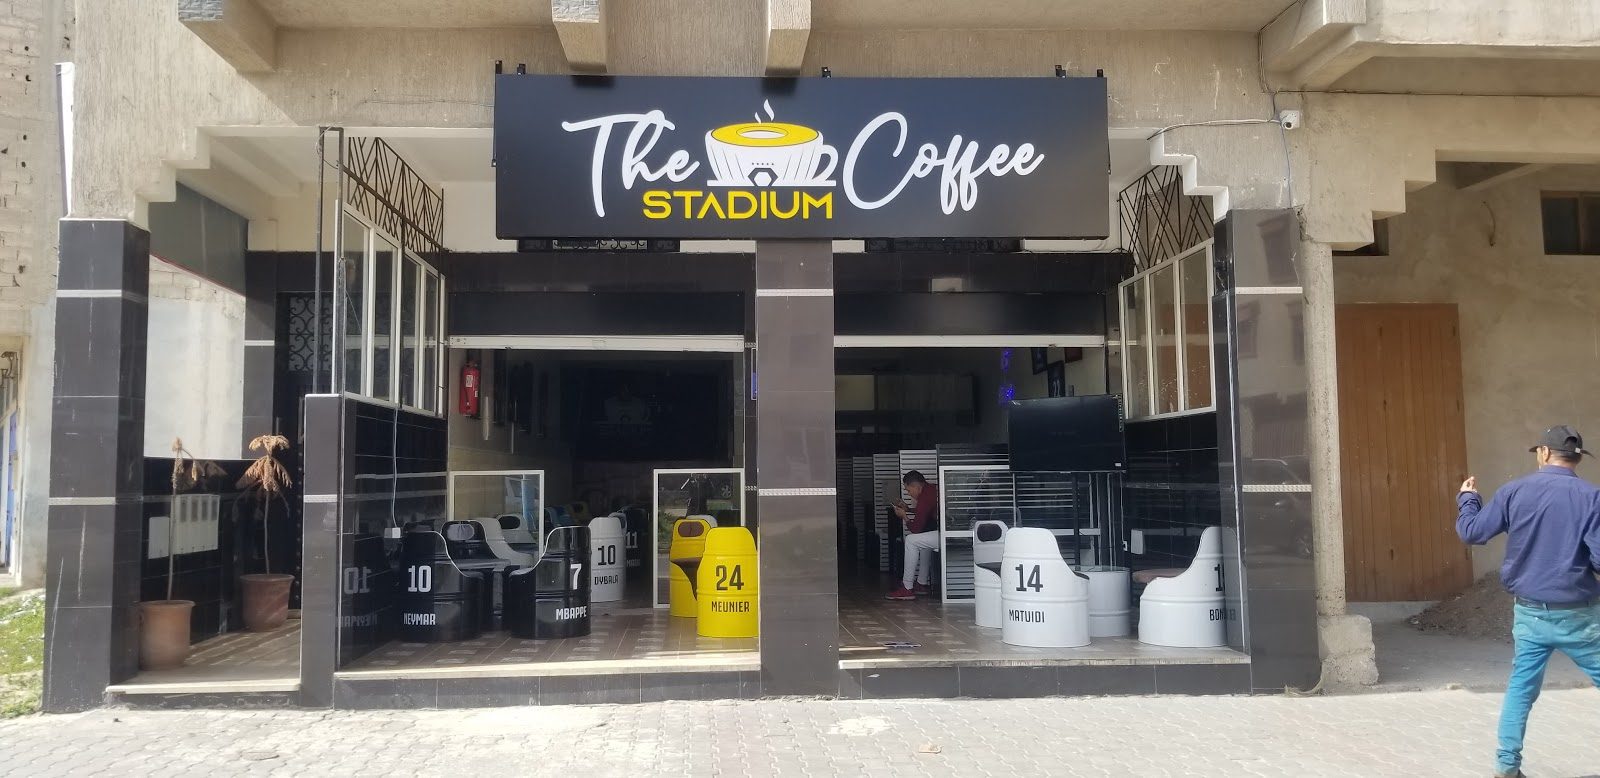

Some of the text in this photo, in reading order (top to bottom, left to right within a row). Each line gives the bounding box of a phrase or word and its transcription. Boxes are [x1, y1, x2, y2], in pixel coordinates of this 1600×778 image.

[561, 109, 1045, 218] The Coffee
[643, 190, 833, 220] STADIUM
[597, 544, 616, 566] 10
[407, 565, 432, 593] 10
[569, 563, 582, 590] 7
[594, 574, 619, 586] DYBALA
[715, 564, 745, 591] 24
[1015, 563, 1043, 592] 14
[403, 612, 436, 626] NEYMAR
[555, 605, 587, 621] MBAPPE
[711, 601, 750, 613] MEUNIER
[1008, 608, 1045, 623] MATUIDI
